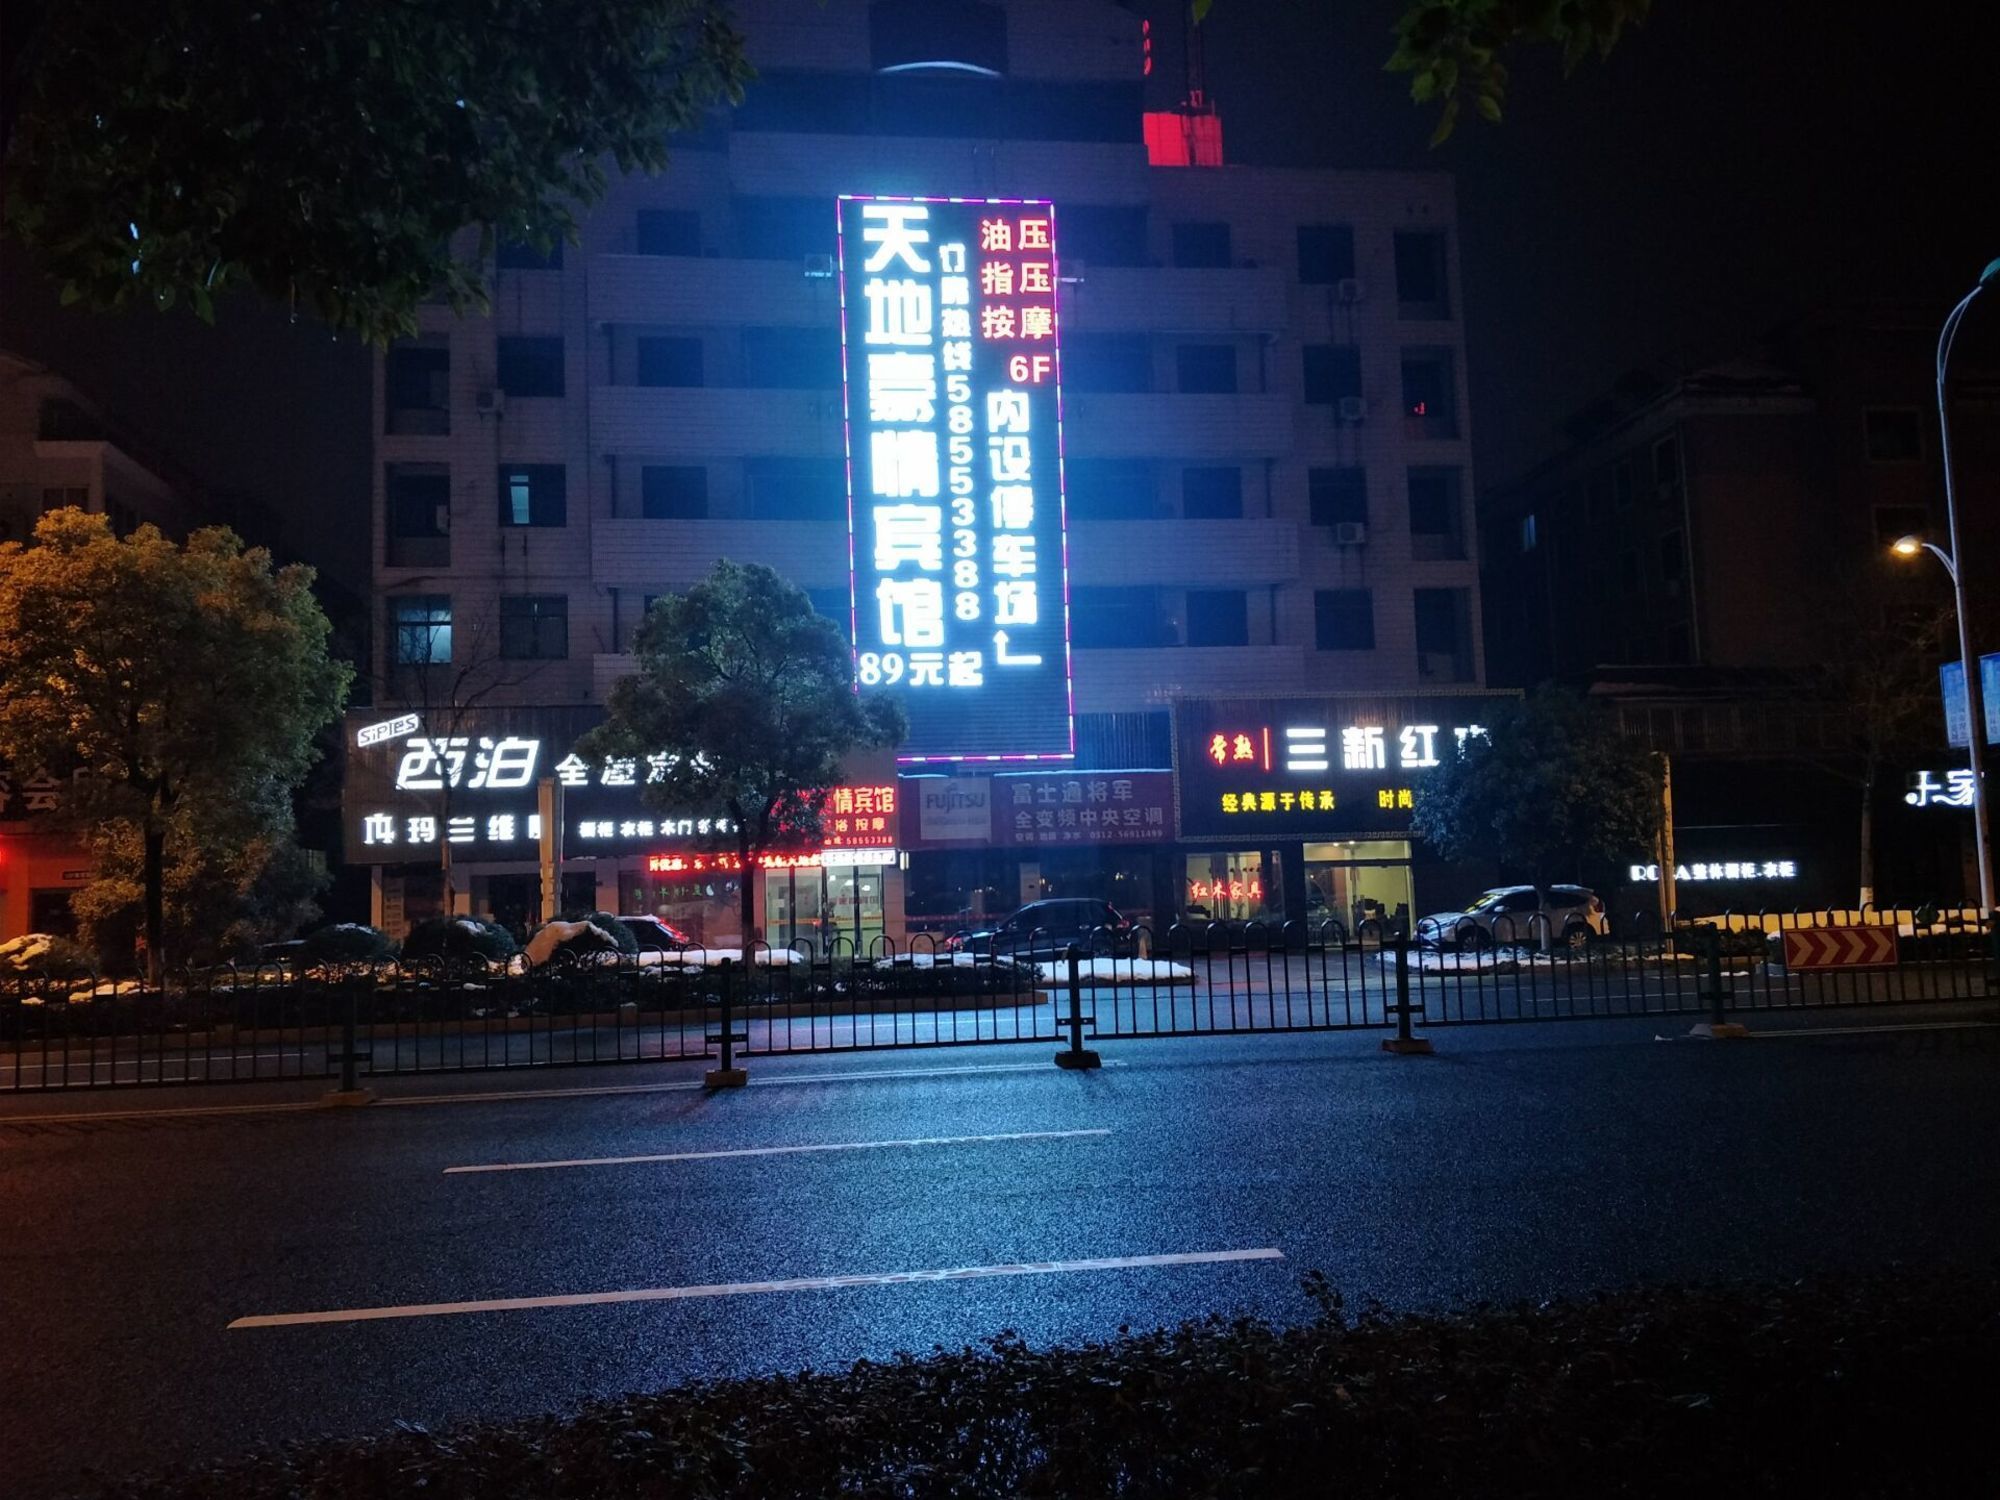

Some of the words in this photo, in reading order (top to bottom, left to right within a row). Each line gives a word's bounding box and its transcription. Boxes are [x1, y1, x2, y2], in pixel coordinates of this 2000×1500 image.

[981, 218, 1050, 251] 油压
[981, 261, 1052, 295] 指压
[981, 305, 1053, 339] 按摩
[1009, 355, 1051, 383] 6F
[862, 205, 945, 648] 天地豪情宾馆
[987, 389, 1038, 625] 内设停车场
[859, 652, 983, 687] 89元起
[926, 791, 985, 814] FUJITSU
[1011, 779, 1134, 805] 富士通将军
[1221, 790, 1336, 813] 经典源于传承
[1014, 807, 1164, 830] 全变频中央空调
[1191, 880, 1262, 899] 红木家具
